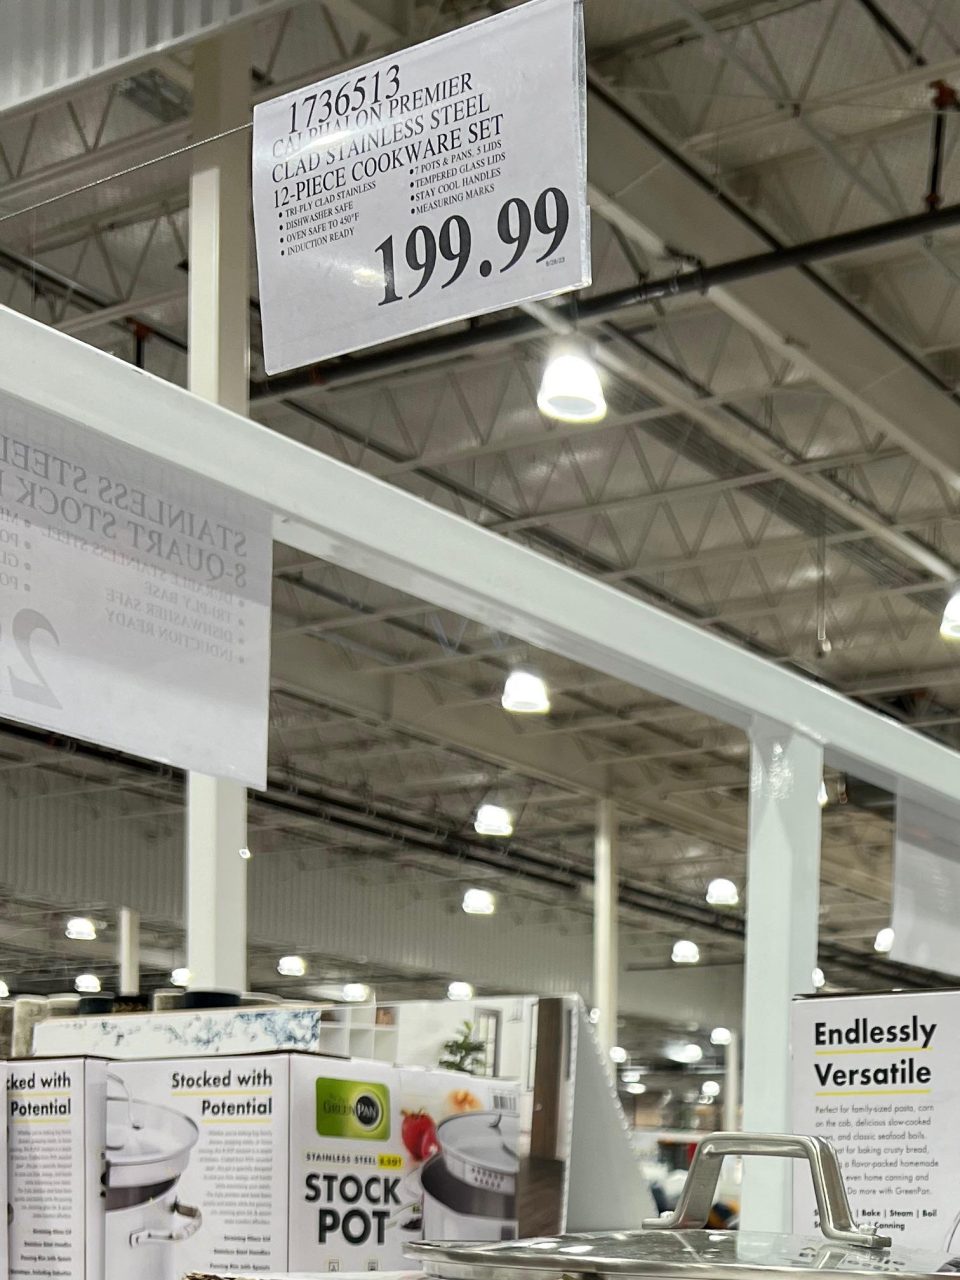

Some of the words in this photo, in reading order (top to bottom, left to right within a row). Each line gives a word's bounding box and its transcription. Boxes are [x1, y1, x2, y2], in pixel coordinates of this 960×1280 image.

[289, 64, 400, 134] 1736513
[389, 72, 472, 118] PREMIER
[272, 152, 320, 183] CLAD
[326, 115, 424, 165] STAINLESS
[430, 92, 490, 129] STEEL
[274, 167, 347, 208] 12-PIECE
[352, 128, 462, 181] COOKWARE
[468, 114, 504, 144] SET
[415, 167, 457, 188] TEMPERED
[459, 159, 485, 173] GLASS
[487, 152, 506, 165] LIDS
[421, 159, 440, 172] POTS
[442, 157, 448, 165] &
[477, 146, 481, 155] 5
[483, 140, 502, 153] LIDS
[314, 194, 335, 207] CLAD
[337, 180, 376, 200] STAINLESS
[415, 188, 435, 201] STAY
[437, 181, 460, 195] COOL
[462, 168, 501, 187] HANDLES
[416, 193, 464, 214] MEASURING
[465, 183, 495, 200] MARKS
[286, 208, 333, 230] DISHWASHER
[334, 201, 353, 214] SAFE
[286, 230, 306, 243] OVEN
[309, 223, 327, 236] SAFE
[328, 219, 338, 229] TO
[287, 236, 327, 255] INDUCTION
[329, 227, 354, 242] READY
[375, 187, 569, 306] 199.99
[815, 1015, 937, 1049] Endlessly
[41, 1070, 71, 1088] with
[172, 1069, 231, 1088] Stocked
[237, 1069, 272, 1087] with
[814, 1058, 931, 1086] Versatile
[11, 1098, 71, 1116] Potential
[201, 1097, 272, 1116] Potential
[305, 1173, 401, 1204] STOCK
[318, 1209, 390, 1246] POT
[861, 1208, 881, 1217] Bake
[889, 1208, 914, 1217] Steam
[922, 1208, 937, 1217] Boil
[874, 1222, 905, 1231] Canning
